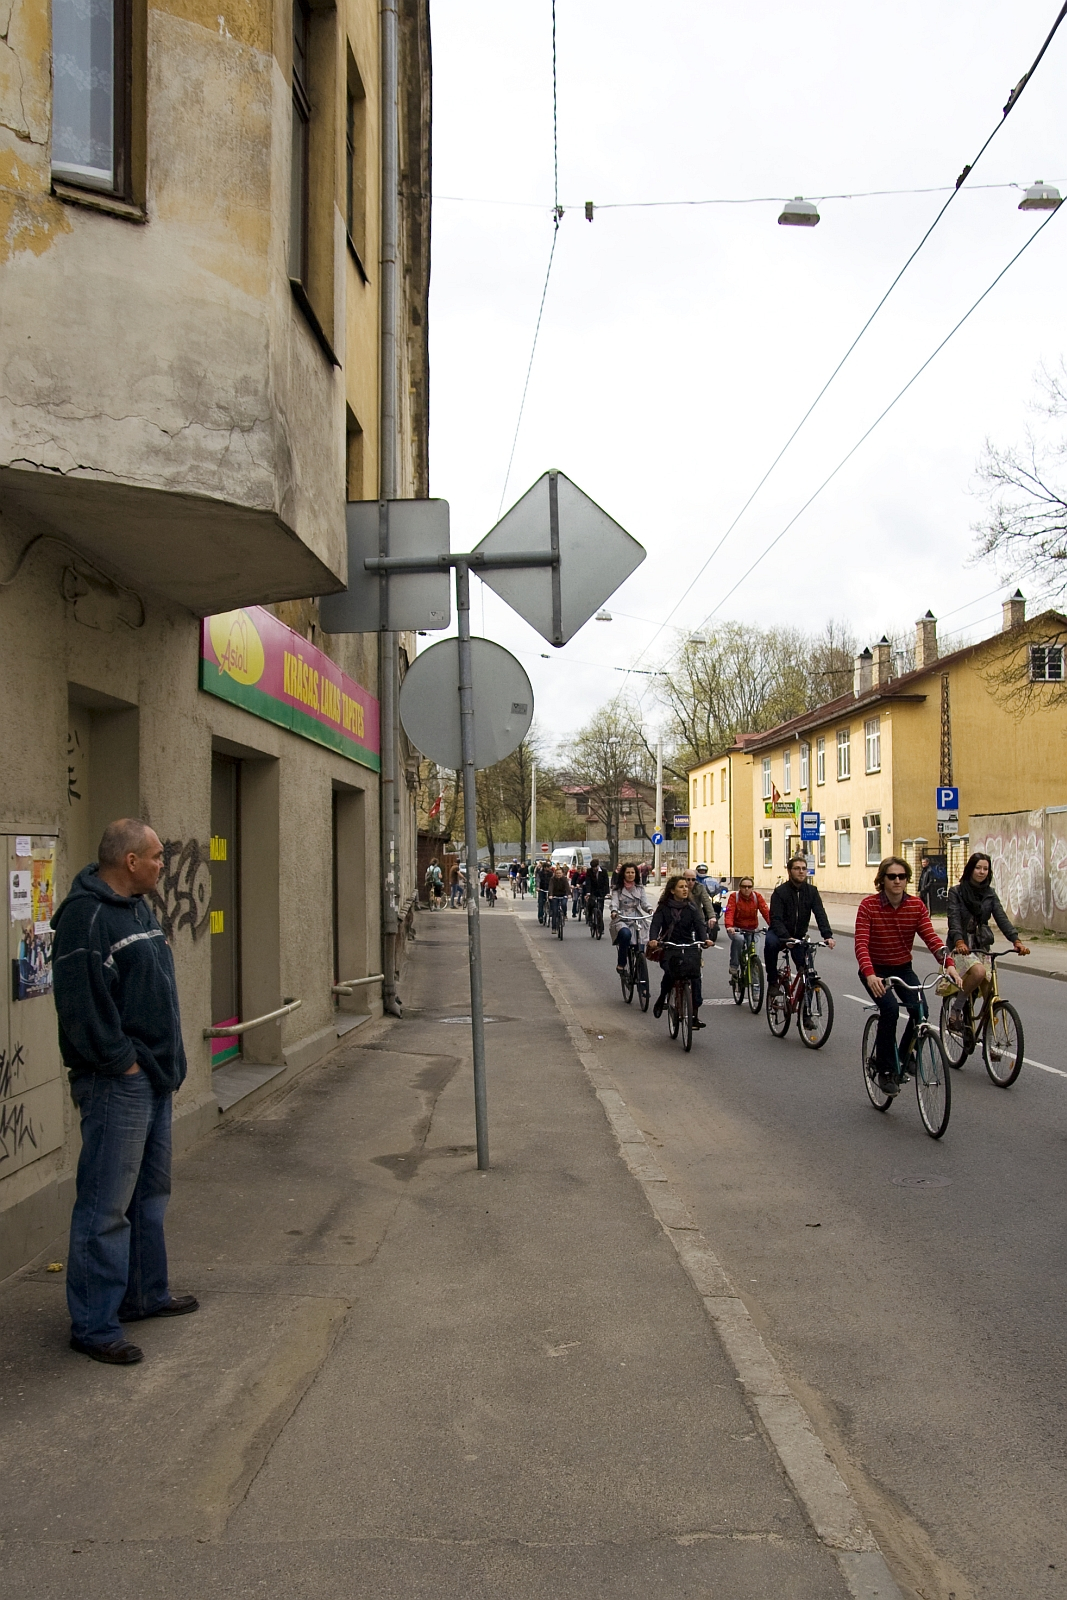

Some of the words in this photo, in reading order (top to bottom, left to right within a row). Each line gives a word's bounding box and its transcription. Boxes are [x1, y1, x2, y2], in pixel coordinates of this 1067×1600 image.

[283, 651, 320, 714] KRĀSAS,
[321, 676, 341, 724] LAKAS
[342, 692, 365, 739] TAPETES
[942, 790, 954, 808] P
